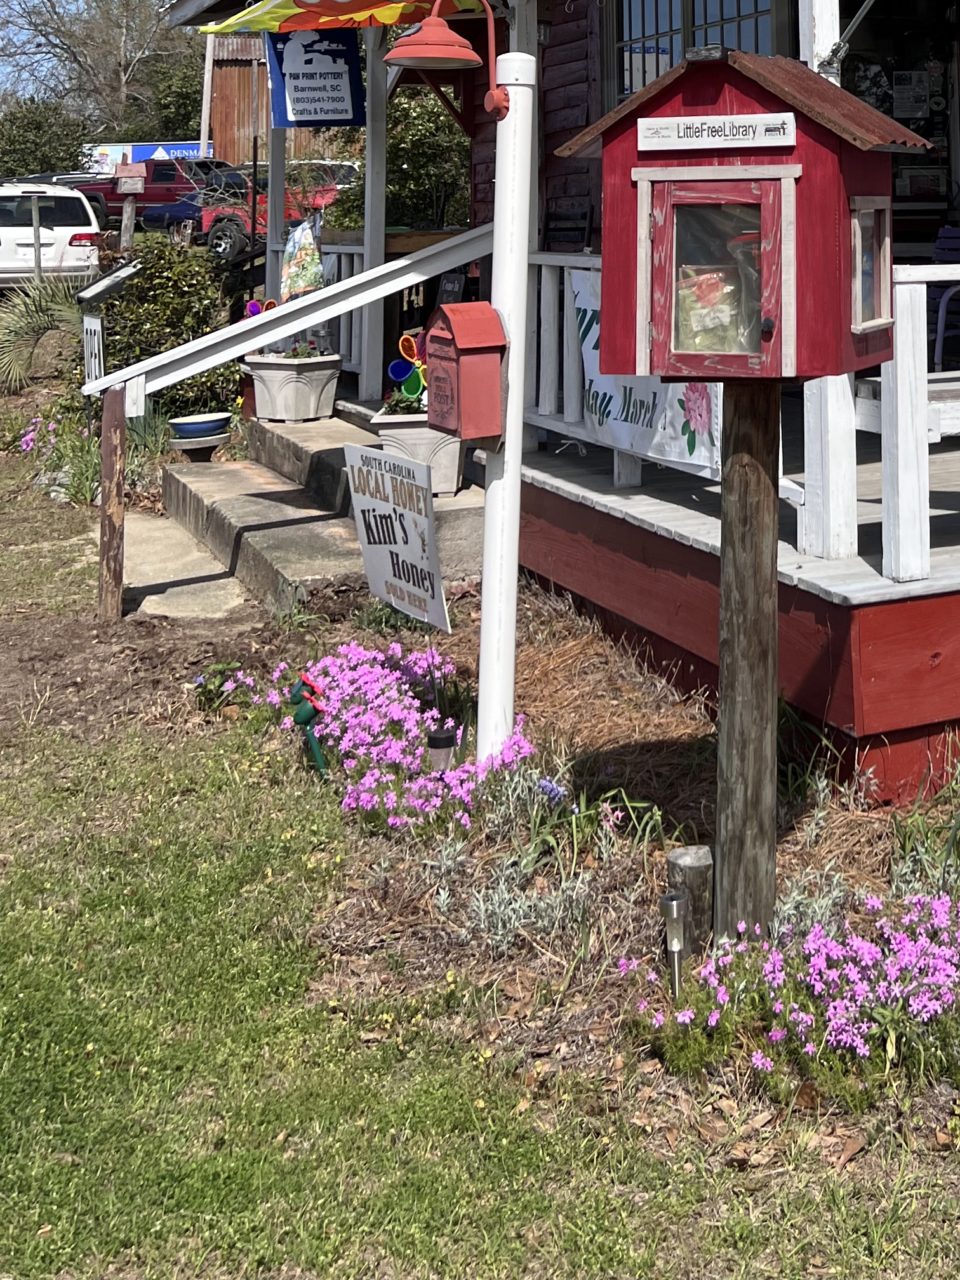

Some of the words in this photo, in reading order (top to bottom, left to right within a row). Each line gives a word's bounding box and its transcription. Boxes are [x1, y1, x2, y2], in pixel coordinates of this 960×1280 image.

[293, 85, 329, 93] Barnwell,
[330, 84, 342, 92] SC
[302, 72, 317, 80] PRINT
[319, 72, 343, 80] POTTERY
[677, 122, 757, 140] LittleFreeLibrary
[585, 379, 613, 426] day,
[361, 454, 382, 471] SOUTH
[384, 461, 416, 482] CAROLINA
[351, 465, 389, 503] LOCAL
[390, 476, 429, 518] HONEY
[361, 507, 409, 546] Kim's
[389, 550, 435, 600] Honey
